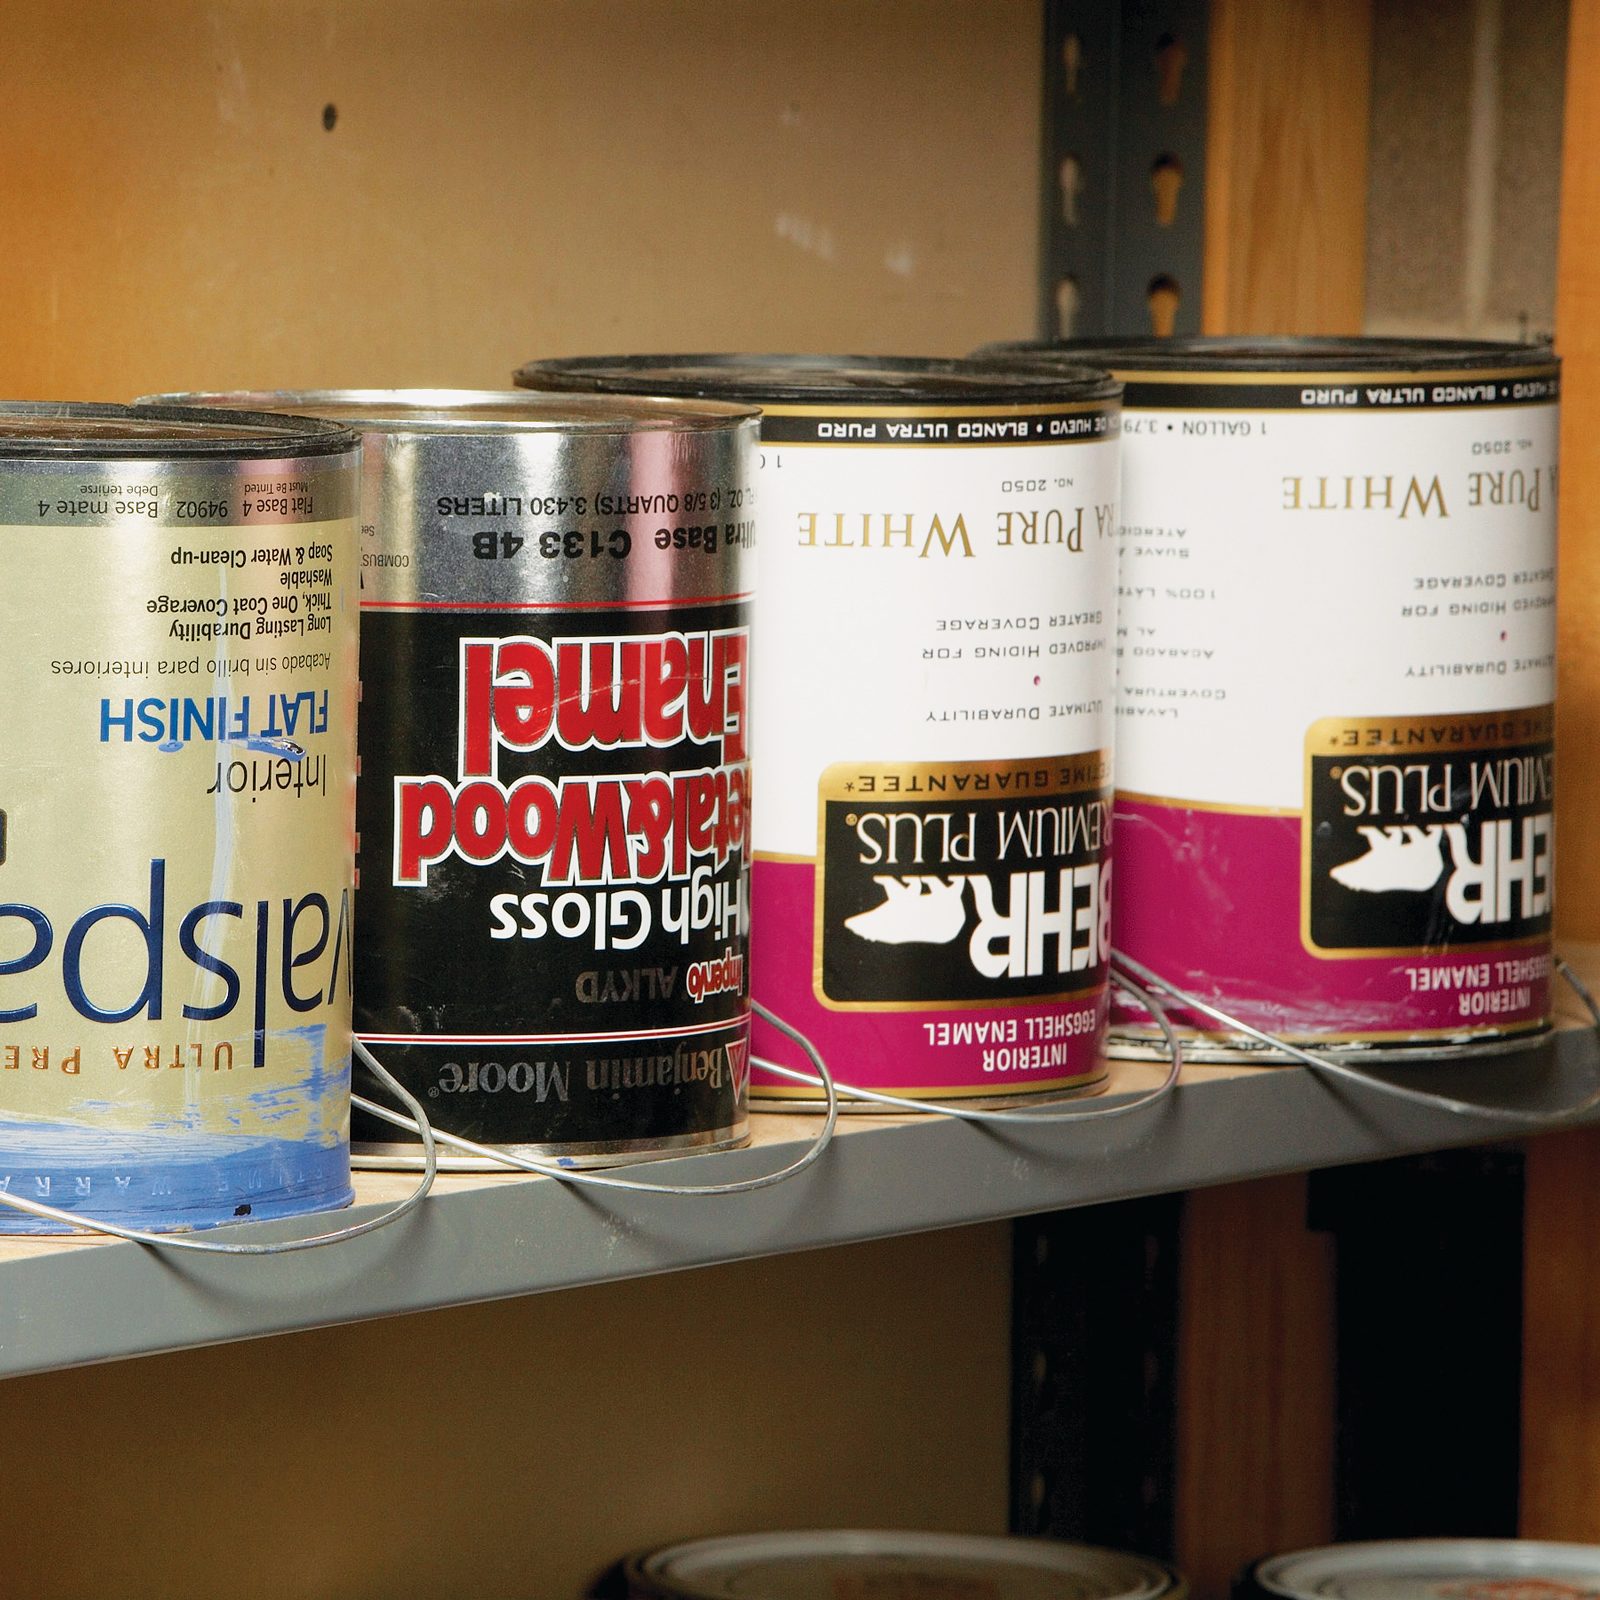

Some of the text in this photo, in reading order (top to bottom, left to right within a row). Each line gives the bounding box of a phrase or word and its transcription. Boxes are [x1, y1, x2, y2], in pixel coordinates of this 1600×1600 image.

[1300, 389, 1358, 405] PURO
[1367, 388, 1424, 403] ULTRA
[1432, 386, 1496, 402] BLANCO
[817, 422, 876, 439] PURO
[886, 422, 948, 439] ULTRA
[958, 422, 1028, 439] BLANCO
[1050, 418, 1091, 435] HUEVO
[1182, 420, 1251, 436] GALLON
[1260, 421, 1267, 436] 1
[1472, 441, 1511, 455] 2050
[127, 485, 158, 497] Debe
[244, 482, 308, 495] Must Be Tinted
[1001, 479, 1046, 493] 2050
[1467, 467, 1541, 512] PURE
[242, 497, 313, 517] Flat Base 4
[437, 496, 522, 517] LITERS
[531, 495, 587, 516] 3.430
[595, 494, 678, 517] QUARTS)
[684, 493, 706, 513] 5/8
[1282, 475, 1450, 519] WHITE
[37, 500, 158, 518] Base mate 4
[176, 500, 228, 518] 94902
[654, 520, 756, 554] Ultra Base
[797, 512, 976, 559] WHITE
[997, 507, 1084, 552] PURE
[171, 543, 333, 568] Soap & Water Clean-up
[472, 530, 632, 560] C133 4B
[359, 554, 410, 568] COMBUS
[280, 568, 332, 586] Washable
[1414, 573, 1507, 590] COVERAGE
[146, 591, 332, 616] Thick, One Coat Coverage
[1402, 605, 1439, 617] FOR
[1449, 602, 1507, 616] HIDING
[169, 616, 331, 642] Long Lasting Durability
[936, 610, 1103, 632] GREATER COVERAGE
[922, 648, 963, 660] FOR
[974, 645, 1040, 659] HIDING
[51, 652, 331, 680] Acabado sin brillo para interiores
[1405, 660, 1507, 677] DURABILITY
[261, 689, 329, 738] FLAT
[458, 625, 751, 782] Enamel
[926, 700, 1103, 722] ULTIMATE DURABILITY
[100, 696, 250, 742] FINISH
[206, 754, 326, 803] Interior
[489, 866, 742, 950] High Gloss
[575, 966, 679, 1004] ALKYD
[1405, 963, 1491, 992] ENAMEL
[1459, 987, 1531, 1017] INTERIOR
[923, 1009, 1096, 1046] EGGSHELL ENAMEL
[4, 1041, 234, 1075] ULTRA PRE
[983, 1042, 1067, 1073] INTERIOR
[586, 1041, 724, 1101] Benjamin
